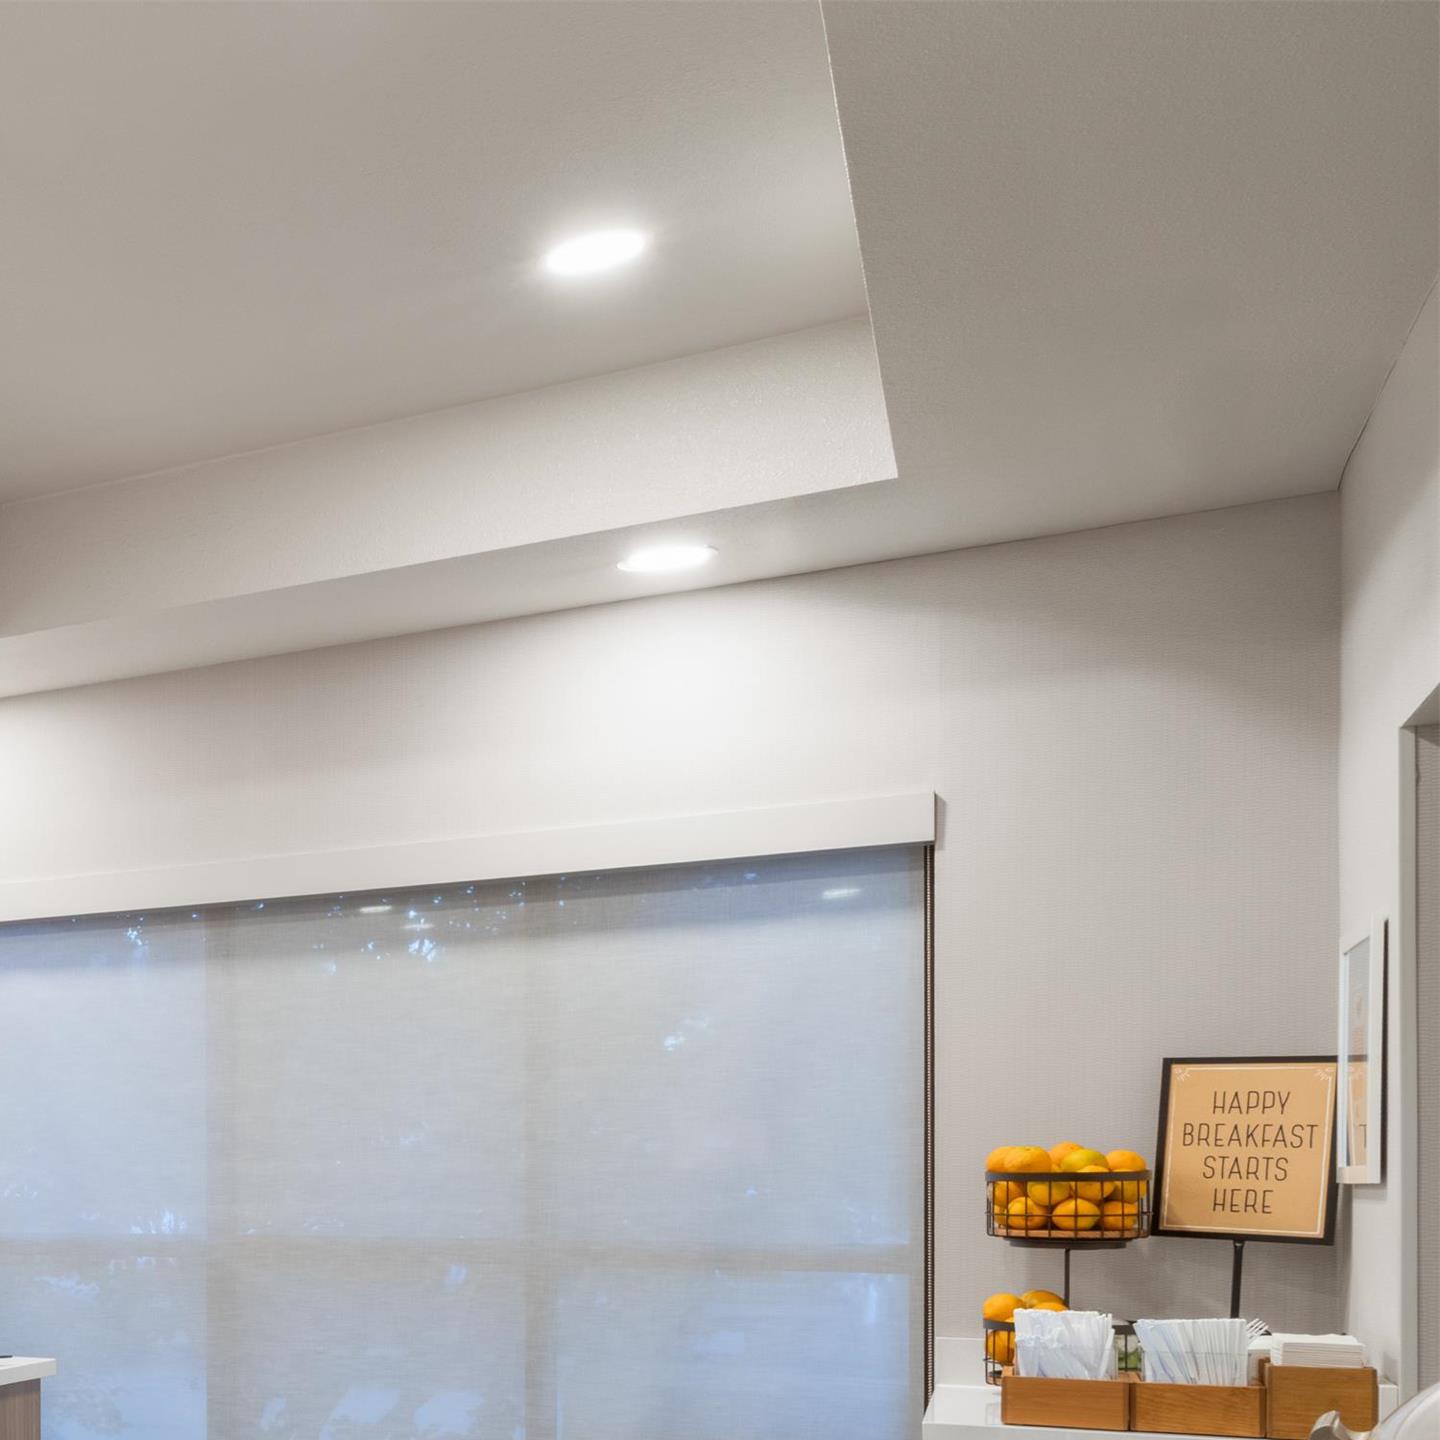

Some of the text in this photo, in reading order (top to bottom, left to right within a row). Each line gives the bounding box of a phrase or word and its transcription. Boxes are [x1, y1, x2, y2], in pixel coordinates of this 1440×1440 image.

[1212, 1090, 1291, 1115] HAPPY
[1182, 1122, 1320, 1149] BREAKFAST
[1202, 1155, 1289, 1182] STARTS
[1212, 1188, 1274, 1214] HERE
